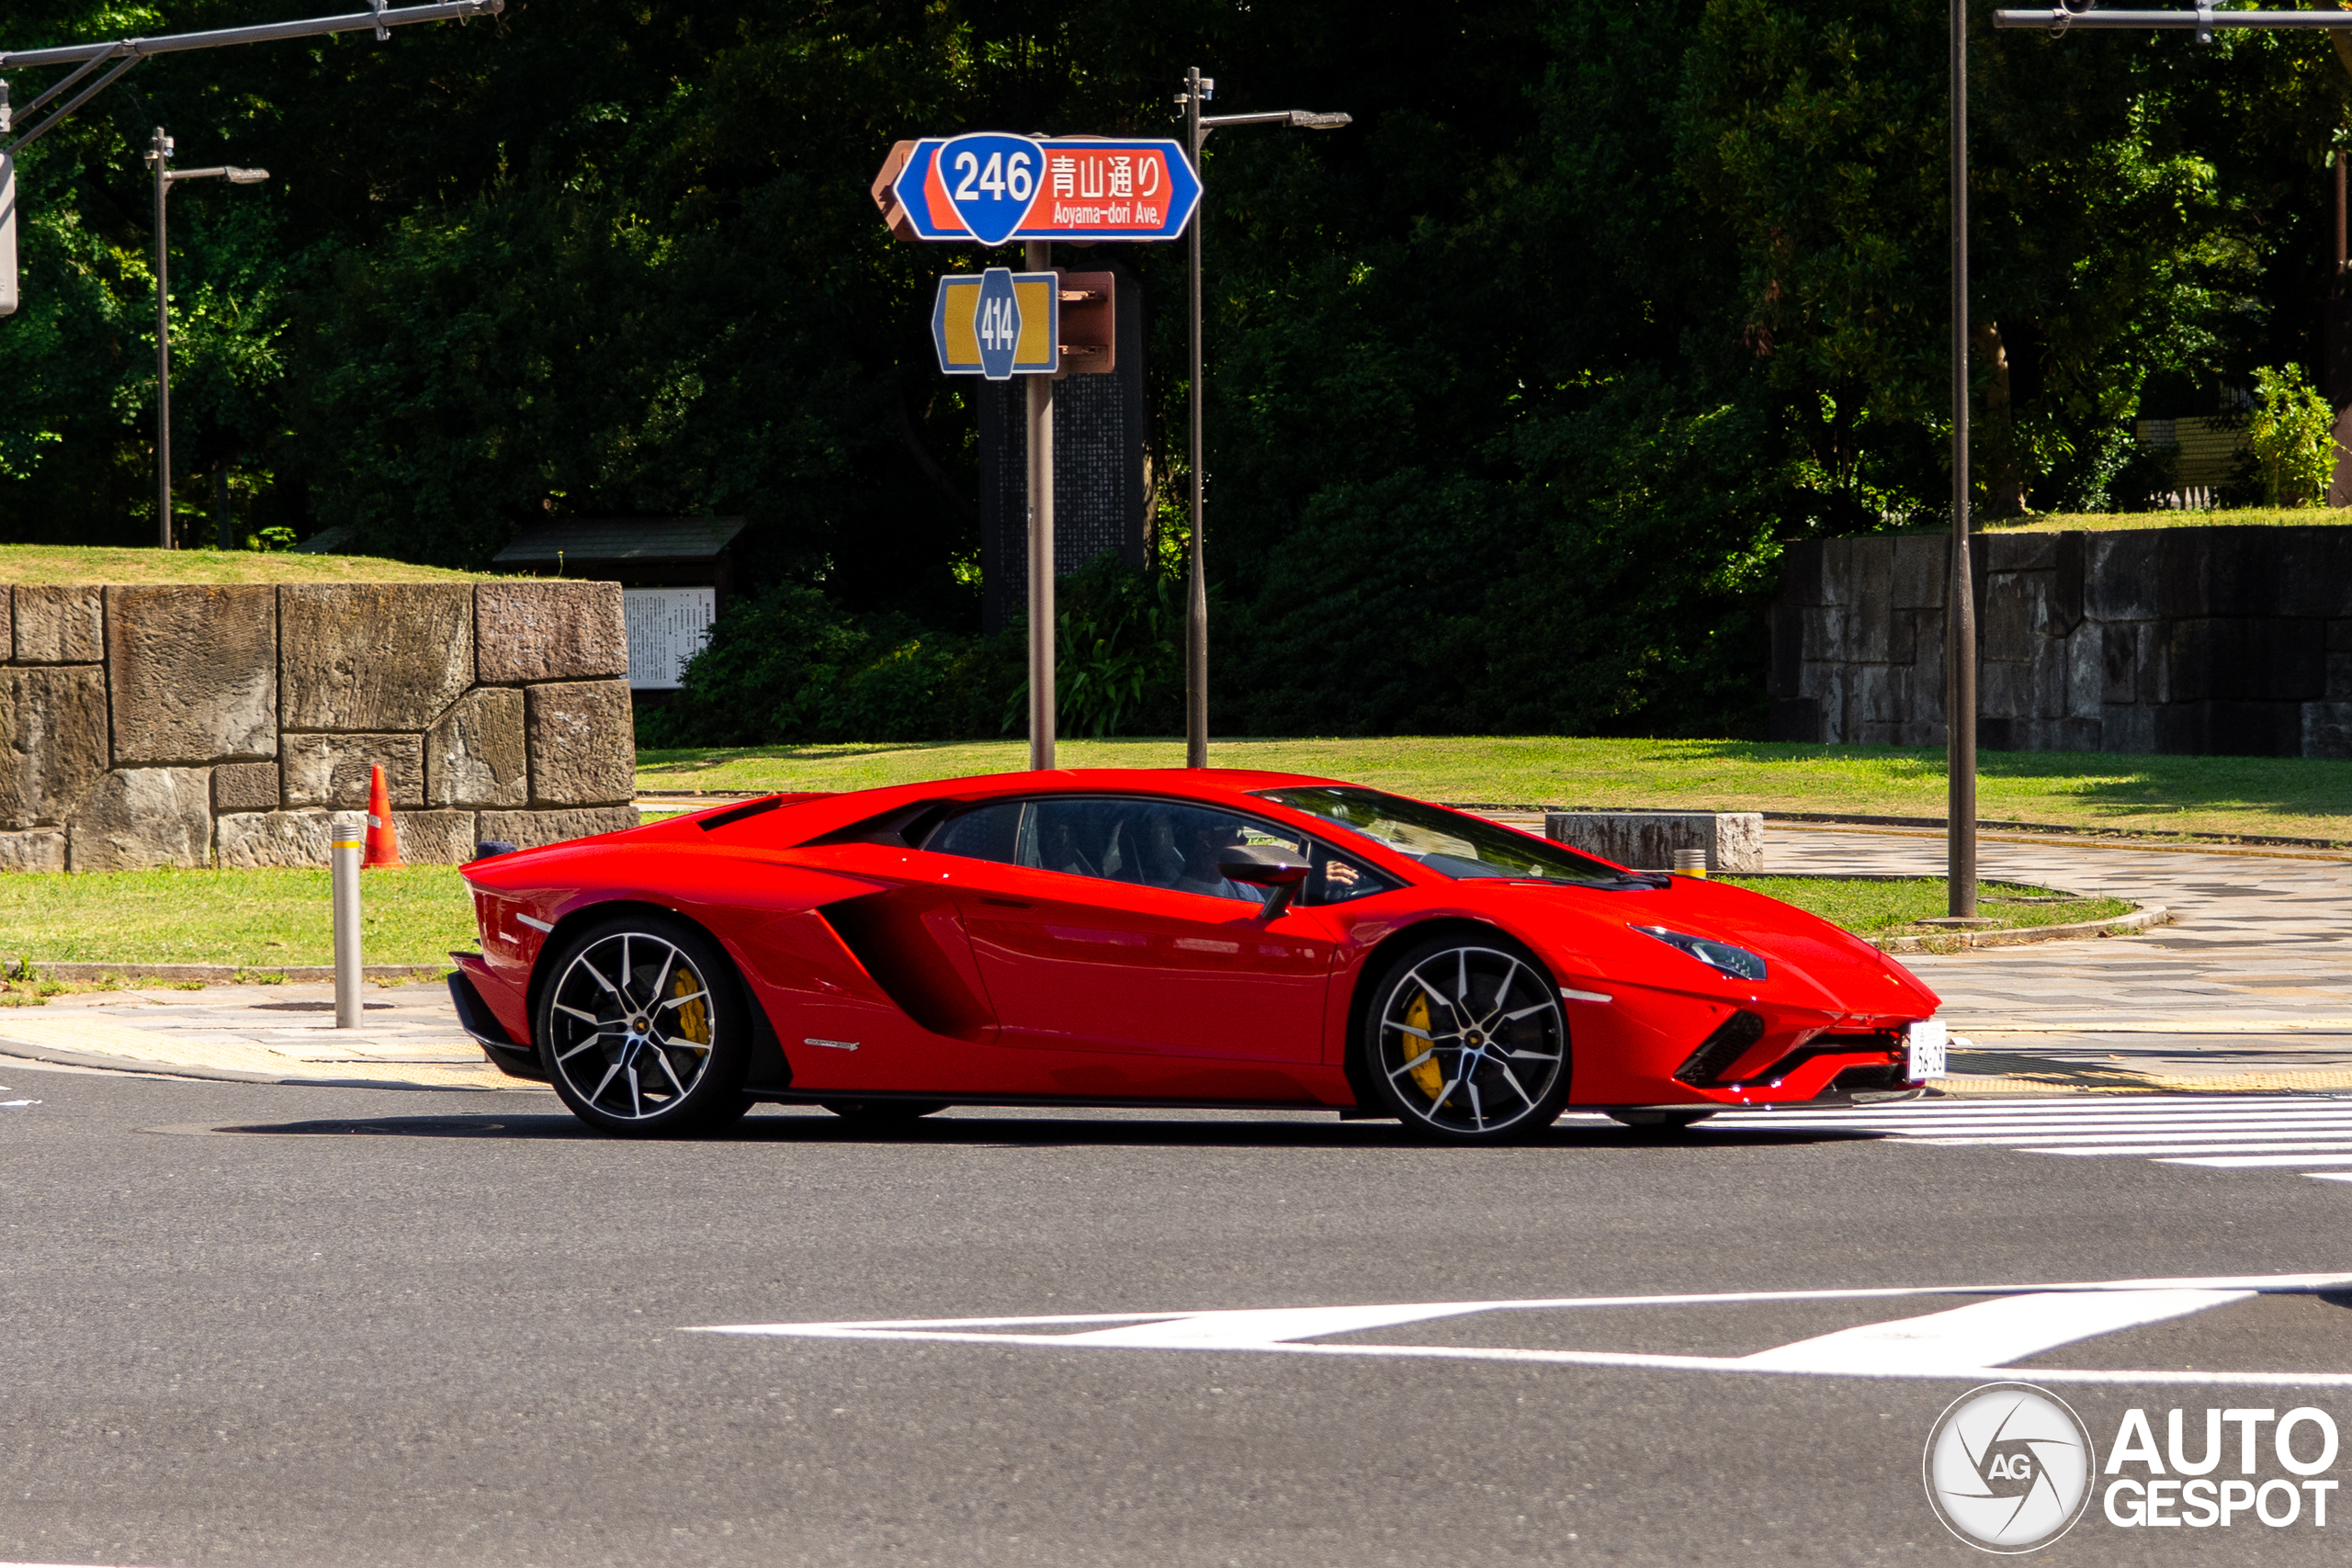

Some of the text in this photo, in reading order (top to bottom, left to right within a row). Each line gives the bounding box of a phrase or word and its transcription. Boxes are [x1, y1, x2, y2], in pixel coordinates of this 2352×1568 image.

[955, 152, 1033, 201] 246
[1050, 155, 1159, 198] 青山通り
[1053, 201, 1161, 228] Aoyama-dori Ave.
[981, 297, 1013, 351] 414
